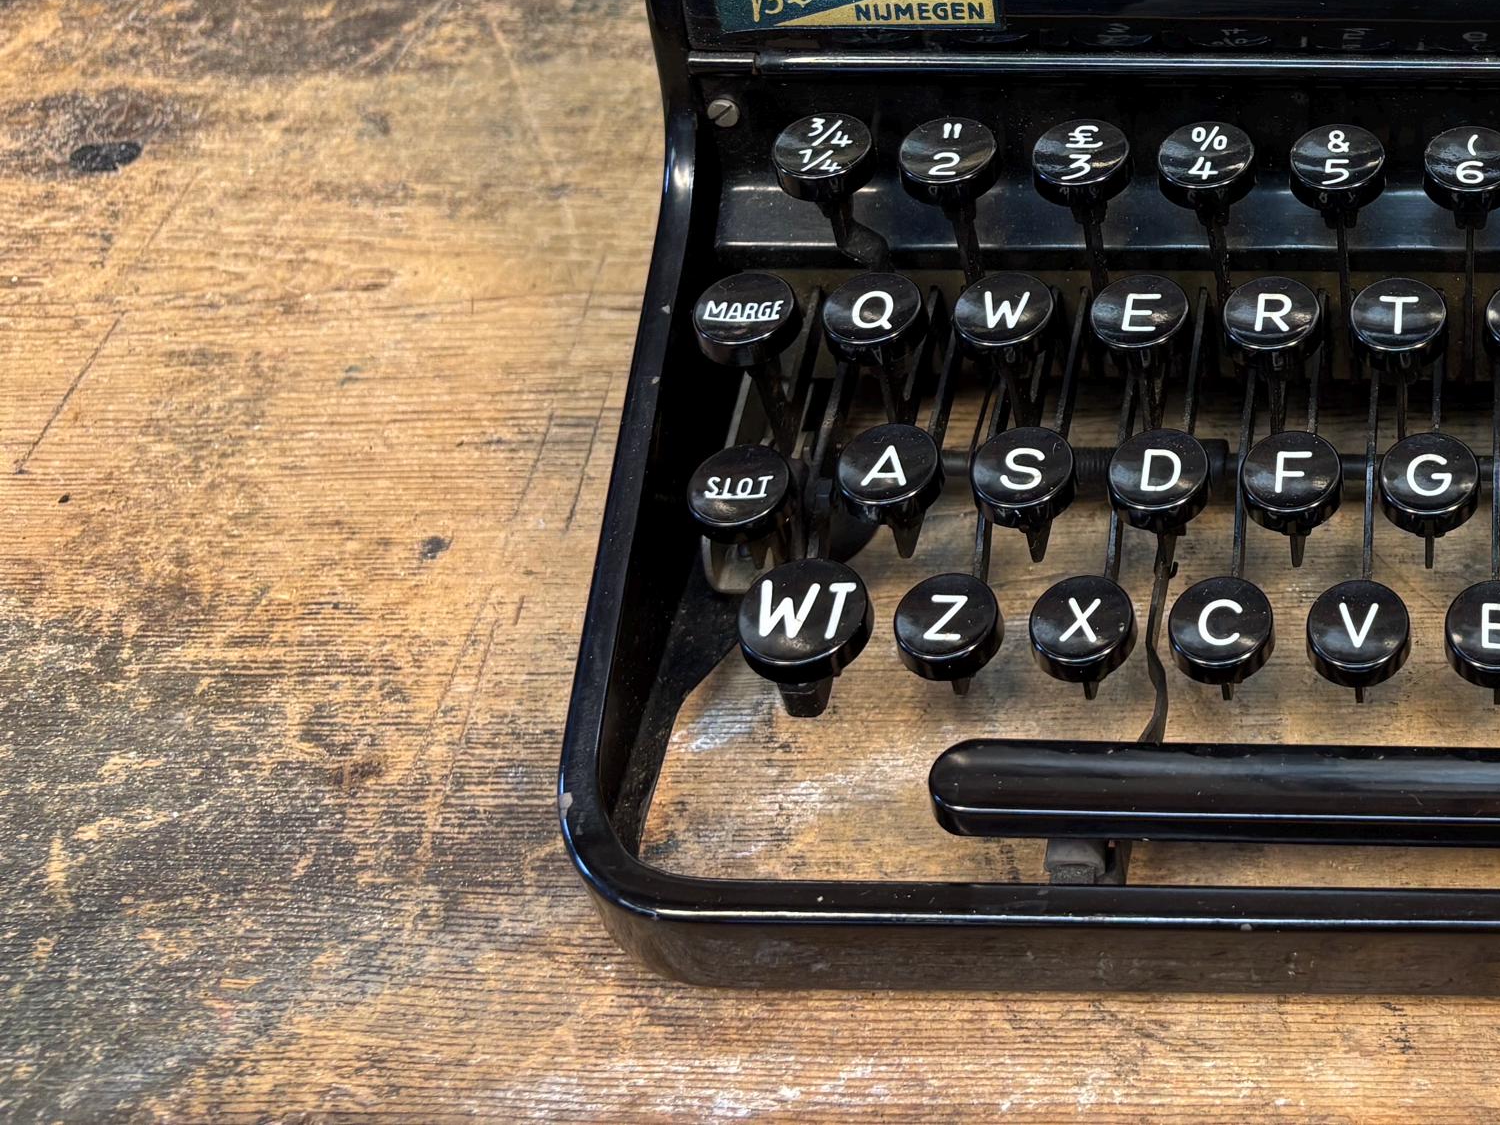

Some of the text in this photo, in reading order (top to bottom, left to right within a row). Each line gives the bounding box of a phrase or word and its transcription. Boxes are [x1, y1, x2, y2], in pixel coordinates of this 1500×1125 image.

[855, 2, 985, 21] NIJMEGEN
[1065, 125, 1104, 149] £
[1191, 125, 1228, 152] %
[1327, 129, 1350, 153] &
[928, 152, 959, 176] 2
[1061, 153, 1092, 180] 3
[1188, 156, 1219, 180] 4
[1321, 159, 1350, 185] 5
[1455, 160, 1484, 184] 6
[702, 299, 785, 323] MARGE
[851, 290, 894, 330] Q
[984, 290, 1030, 329] W
[1121, 293, 1162, 332] E
[1254, 293, 1293, 332] R
[1379, 295, 1419, 335] T
[860, 445, 907, 486] A
[999, 447, 1046, 490] S
[1140, 448, 1182, 492] D
[1274, 450, 1313, 494] F
[1406, 453, 1453, 497] G
[703, 475, 774, 500] SLOT
[758, 579, 857, 640] WT
[923, 594, 968, 641] Z
[1059, 597, 1101, 643] X
[1197, 598, 1243, 646] C
[1338, 602, 1379, 648] V
